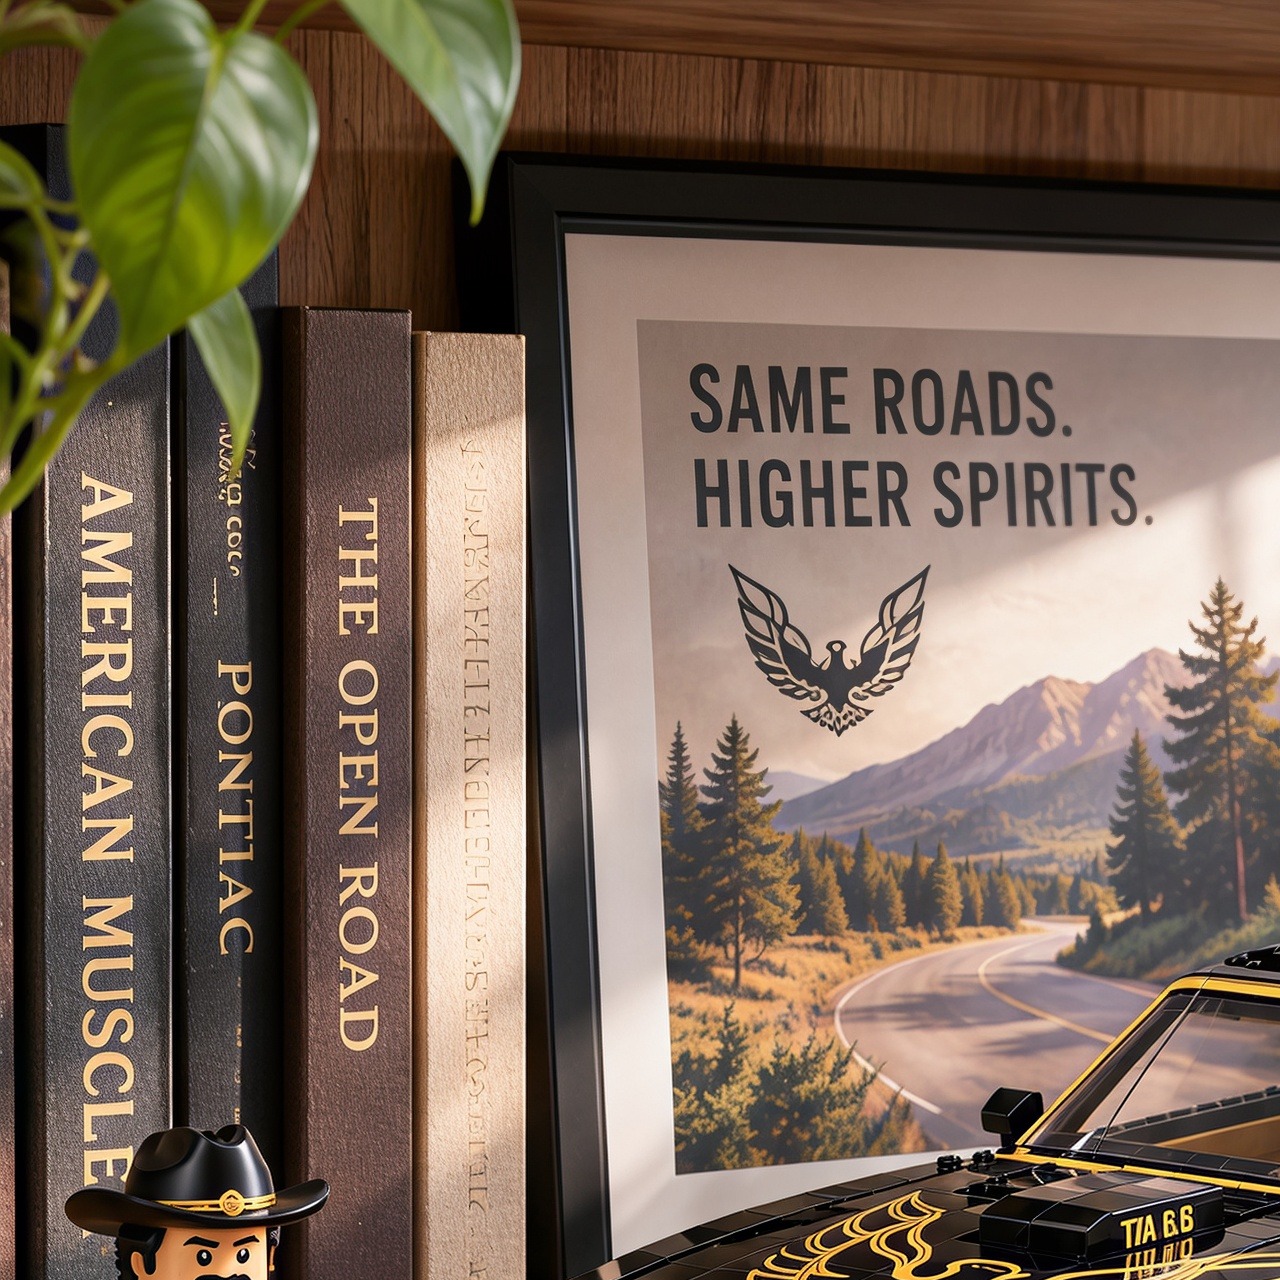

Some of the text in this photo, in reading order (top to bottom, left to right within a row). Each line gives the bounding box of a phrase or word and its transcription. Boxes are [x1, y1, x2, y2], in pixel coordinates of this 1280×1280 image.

[689, 362, 1073, 438] SAME ROADS.
[693, 458, 1154, 529] HIGHER SPIRITS.
[79, 470, 135, 863] AMERICAN
[217, 659, 254, 956] PONTIAC
[338, 496, 380, 1052] THE OPEN ROAD
